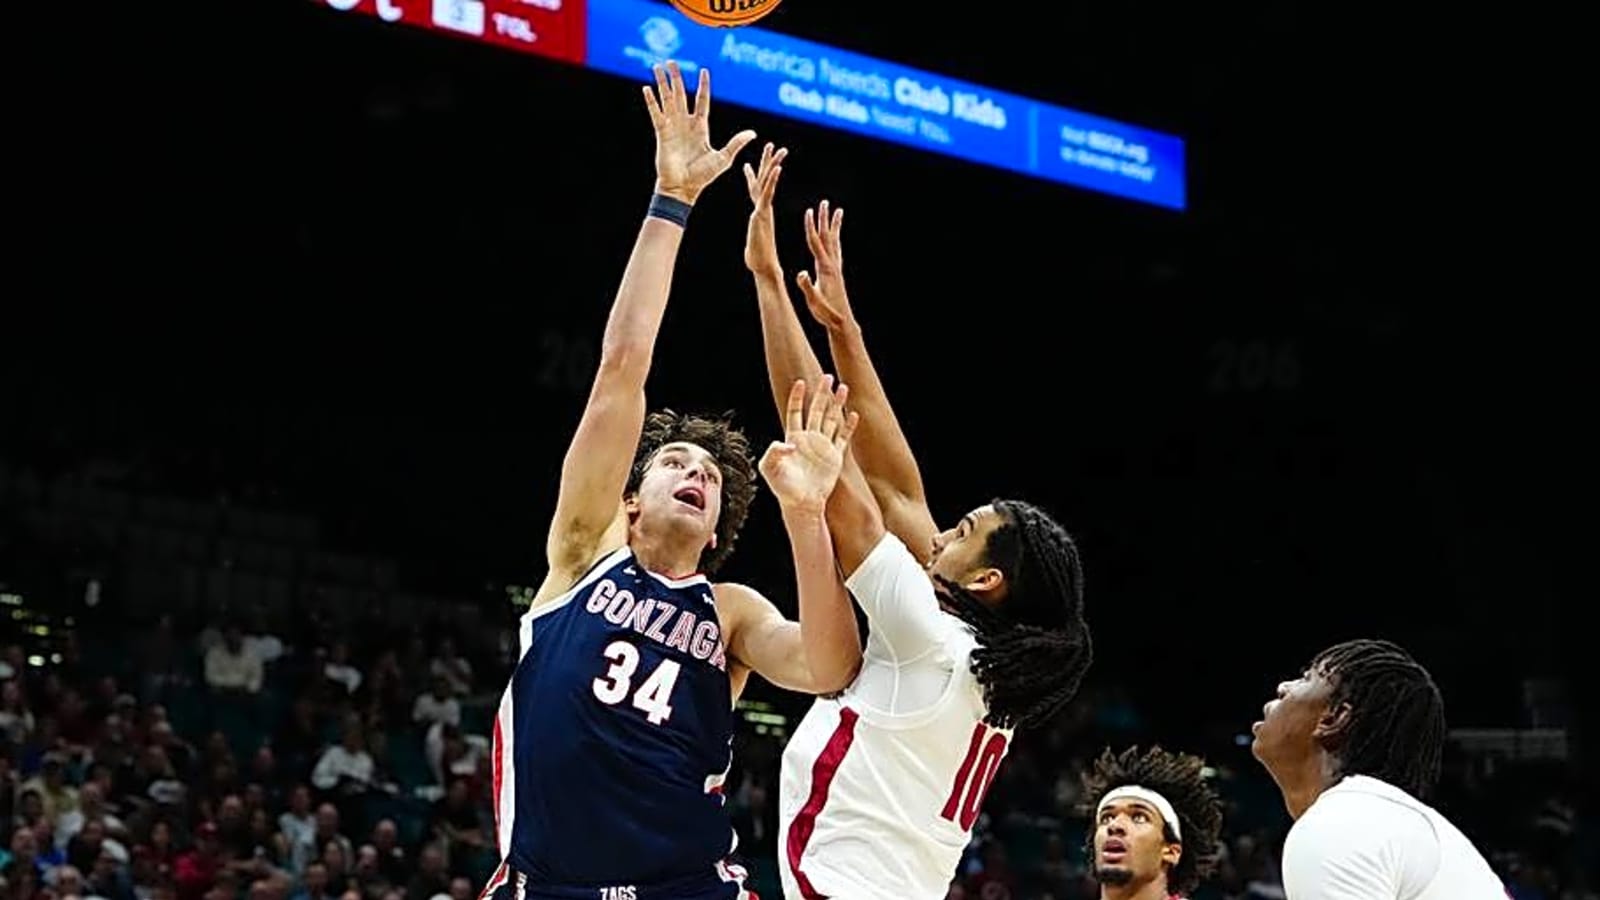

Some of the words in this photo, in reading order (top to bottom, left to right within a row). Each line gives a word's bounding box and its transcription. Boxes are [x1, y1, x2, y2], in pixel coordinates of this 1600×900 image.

[721, 33, 815, 81] America
[894, 77, 949, 115] Club
[952, 91, 1006, 130] Kids
[779, 82, 824, 113] Club
[825, 94, 869, 124] Kids
[1207, 338, 1301, 392] 206
[593, 641, 681, 725] 34
[941, 722, 1007, 833] 10
[600, 885, 637, 900] ZAGS
